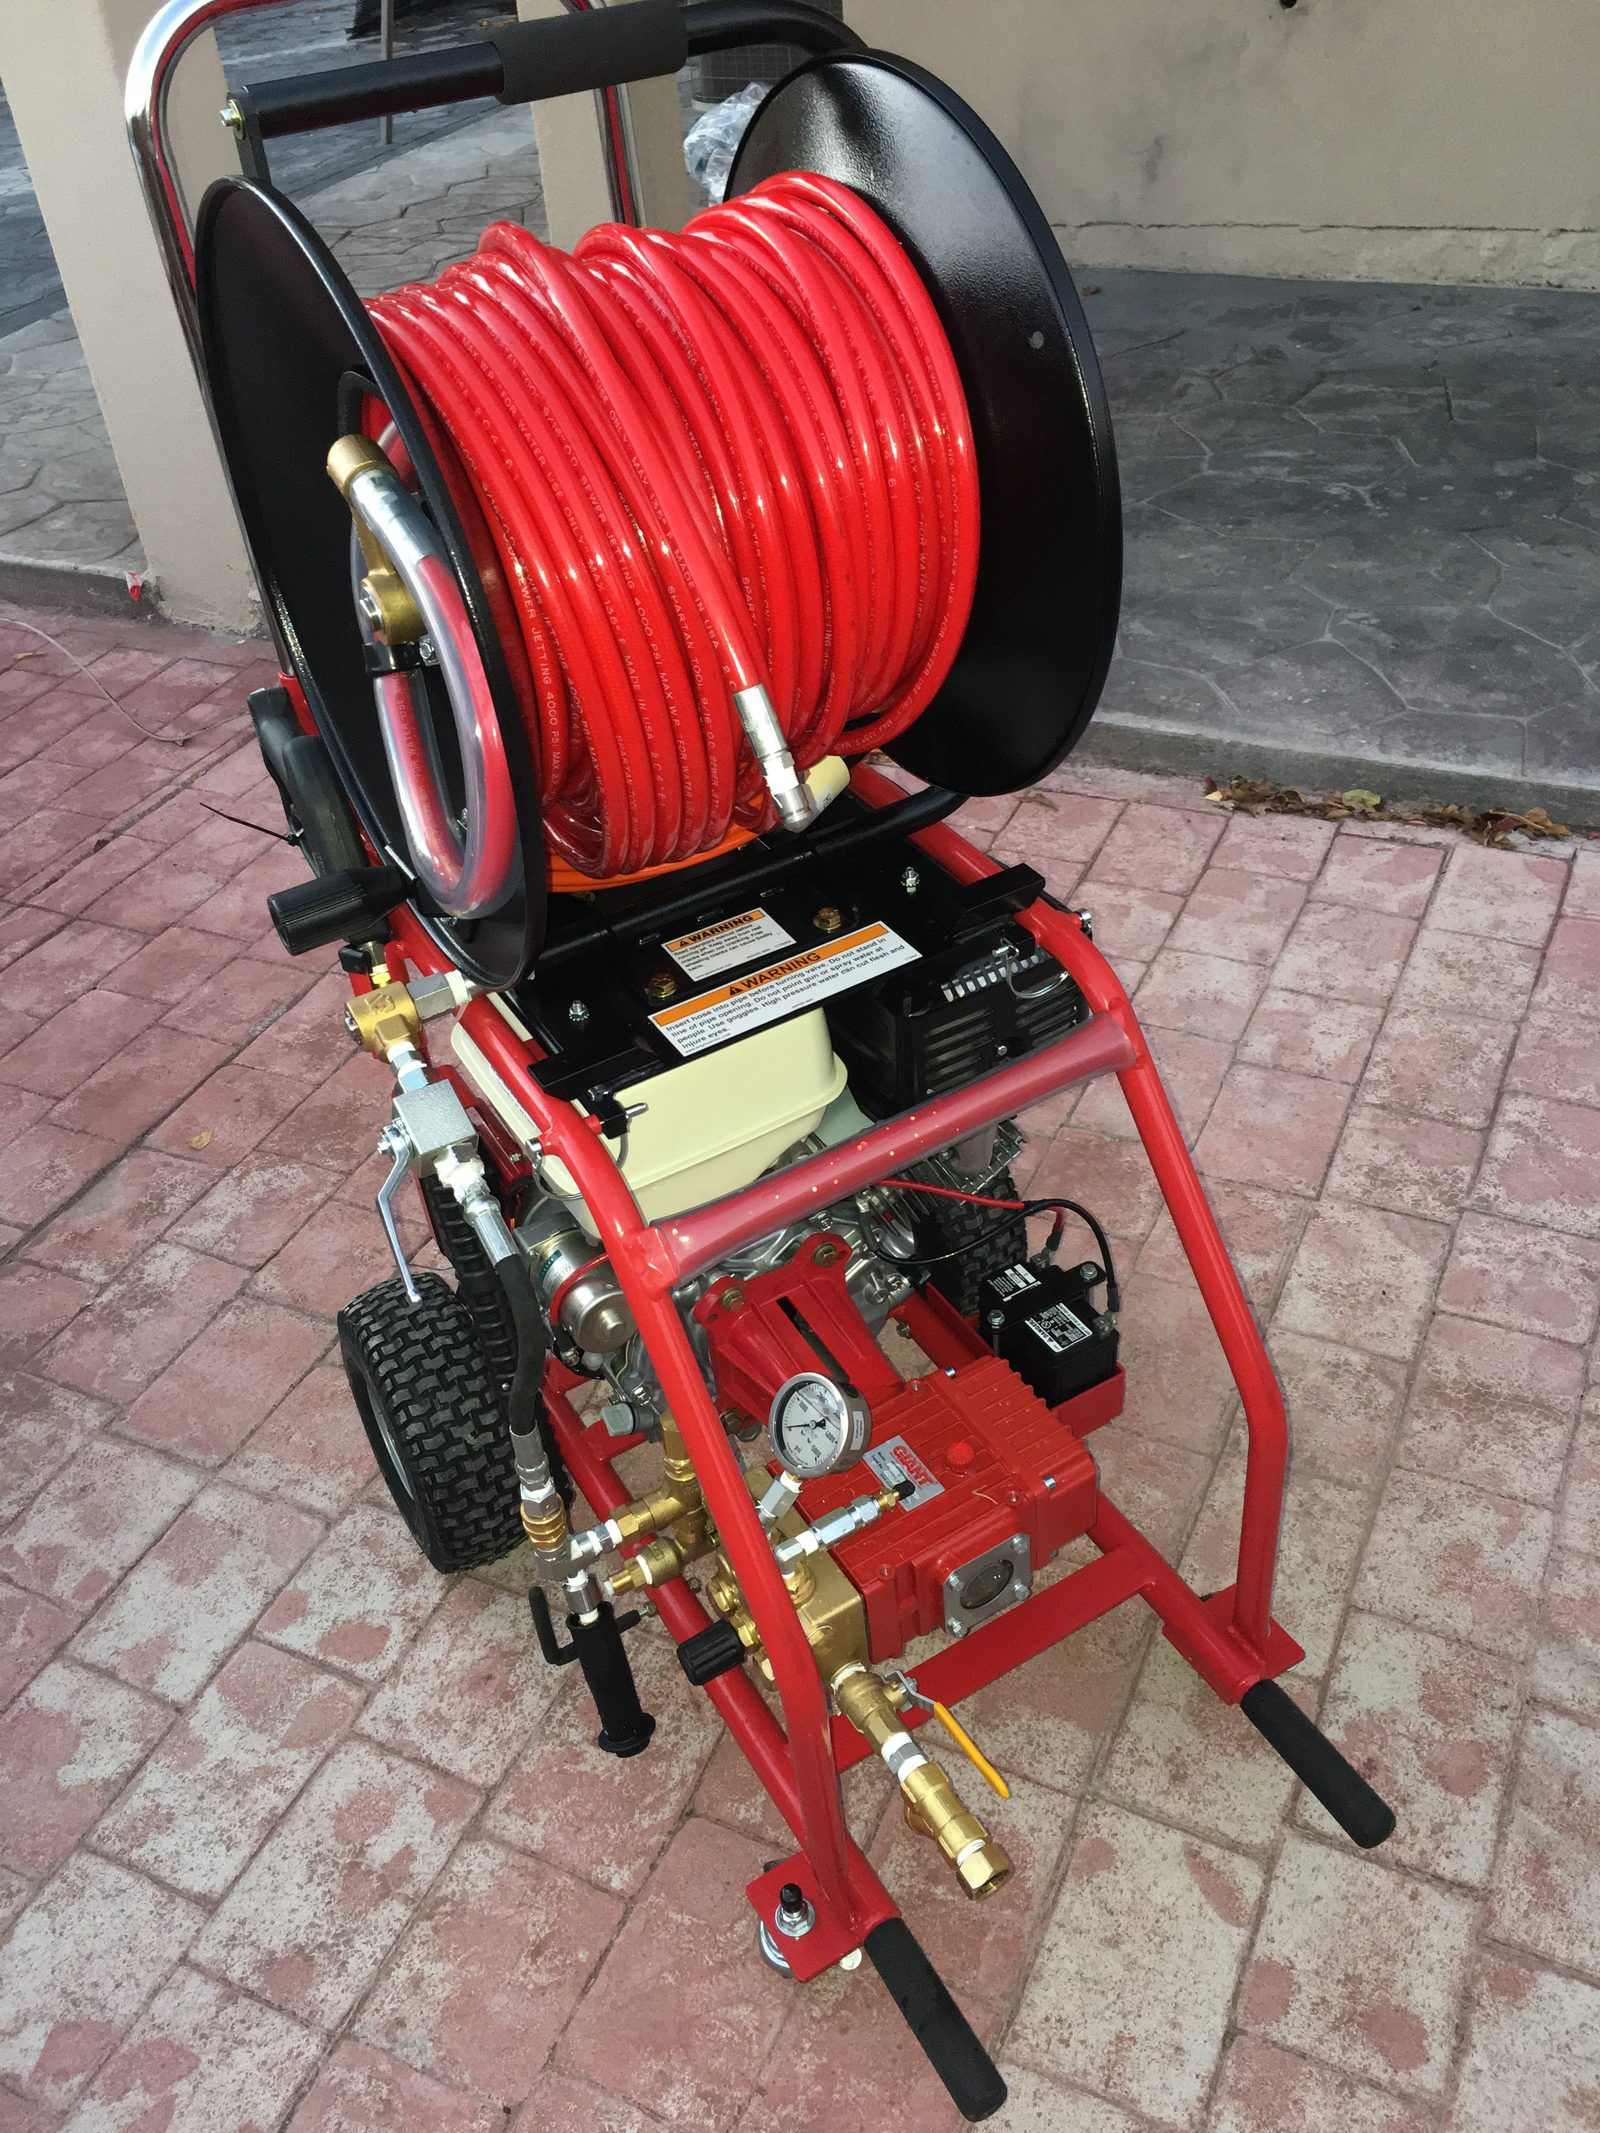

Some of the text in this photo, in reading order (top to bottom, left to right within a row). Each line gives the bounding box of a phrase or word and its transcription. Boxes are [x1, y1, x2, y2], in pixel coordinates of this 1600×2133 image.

[516, 418, 546, 465] WATER
[546, 471, 563, 498] USE
[623, 654, 640, 690] MADE
[637, 696, 646, 710] IN
[642, 716, 654, 739] USA
[531, 625, 551, 685] JETTING
[579, 475, 606, 522] SEWER
[605, 530, 634, 588] JETTING
[631, 597, 653, 636] 4000
[650, 642, 662, 665] PSI
[659, 671, 672, 699] MAX
[682, 765, 691, 796] WATER
[666, 584, 693, 649] SPARTAN
[691, 658, 704, 690] TOOL
[703, 618, 719, 649] USA
[546, 691, 557, 725] 4000
[551, 730, 559, 746] PSI
[615, 734, 632, 784] SPARTAN
[688, 914, 754, 942] WARNING
[664, 1018, 691, 1032] Insert
[690, 1009, 712, 1021] hose
[711, 1002, 730, 1012] into
[728, 994, 750, 1006] pipe
[747, 983, 776, 997] before
[774, 971, 806, 987] turning
[803, 961, 828, 974] valve.
[827, 956, 842, 964] Do
[840, 950, 856, 959] not
[854, 941, 878, 953] stand
[670, 1027, 688, 1037] line
[697, 1015, 718, 1027] pipe
[716, 1000, 754, 1019] opening.
[752, 995, 766, 1003] Do
[765, 988, 781, 997] not
[780, 979, 804, 992] point
[802, 973, 821, 983] gun
[829, 960, 853, 972] spray
[851, 950, 875, 961] water
[675, 1027, 709, 1044] people.
[707, 1020, 726, 1030] Use
[725, 1004, 762, 1023] goggles.
[760, 996, 783, 1008] High
[781, 982, 819, 1000] pressure
[816, 972, 840, 984] water
[839, 966, 856, 974] can
[854, 959, 870, 968] cut
[868, 951, 890, 962] flesh
[888, 944, 905, 954] and
[740, 952, 822, 989] WARNING
[681, 1035, 708, 1050] injure
[706, 1026, 731, 1039] eyes.
[890, 1442, 934, 1488] GIANT
